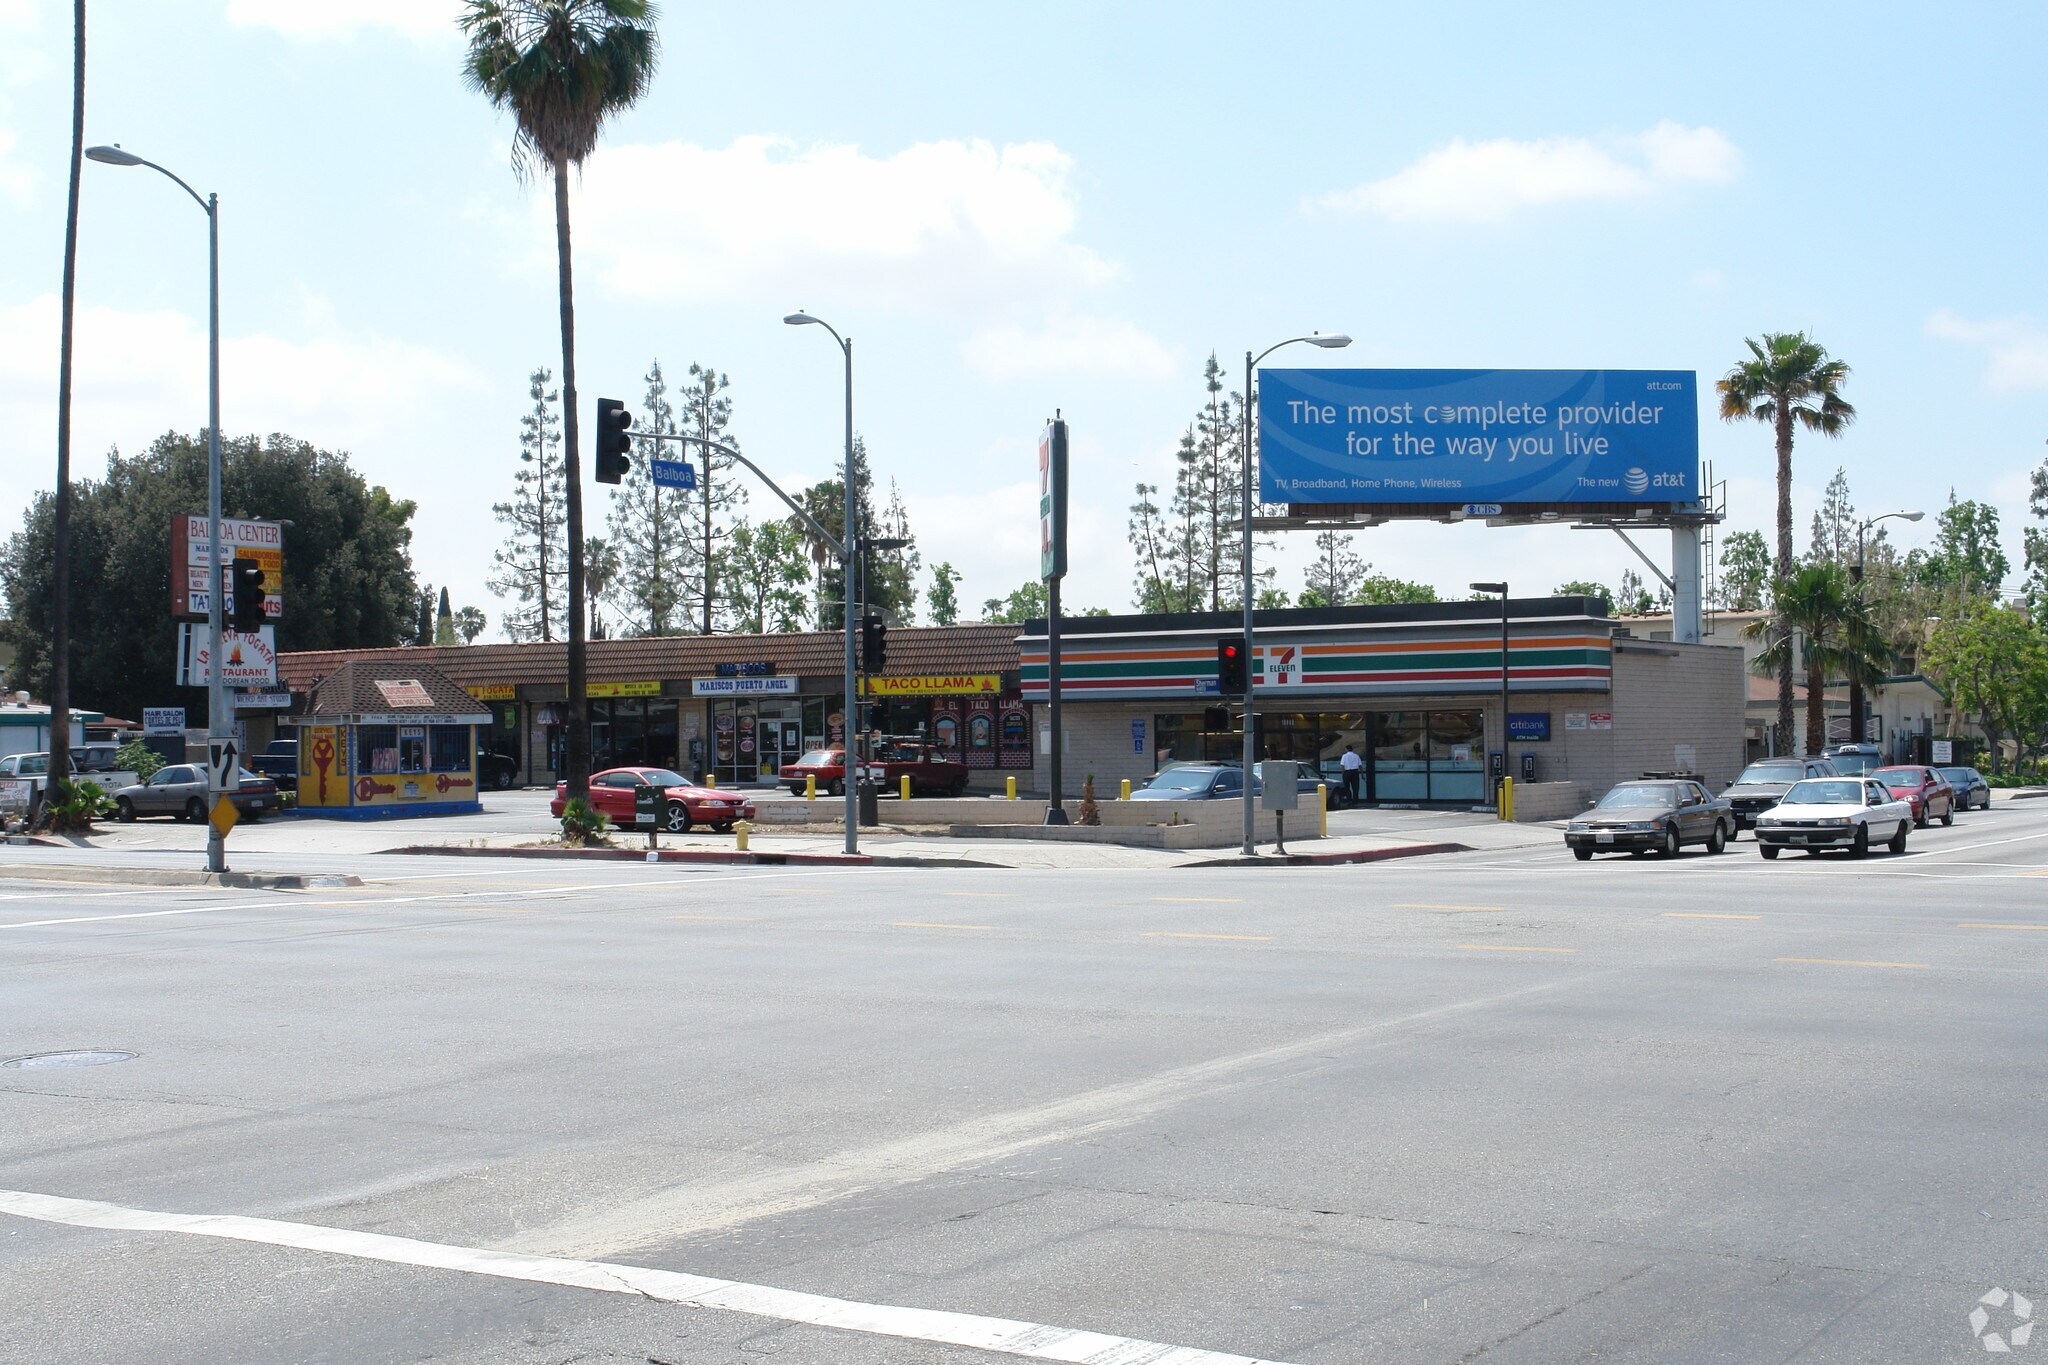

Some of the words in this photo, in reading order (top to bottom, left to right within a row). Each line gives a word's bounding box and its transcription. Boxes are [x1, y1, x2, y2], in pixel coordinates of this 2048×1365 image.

[1646, 380, 1682, 391] att.com
[1288, 401, 1336, 424] The
[1348, 402, 1413, 424] most
[1424, 400, 1547, 430] complete
[1558, 400, 1664, 430] provider
[1346, 431, 1383, 454] for
[1392, 432, 1436, 454] the
[1446, 437, 1499, 462] way
[1508, 437, 1554, 462] you
[1564, 431, 1608, 454] live
[655, 466, 692, 482] Balboa
[1274, 478, 1290, 490] TV,
[1292, 478, 1348, 490] Broadband,
[1352, 478, 1380, 488] Home
[1384, 478, 1418, 490] Phone,
[1421, 478, 1462, 488] Wireless
[1577, 477, 1596, 487] The
[1598, 478, 1619, 487] new
[1652, 471, 1686, 488] at&t
[1477, 505, 1497, 514] CBS
[191, 520, 234, 540] BALOA
[238, 524, 278, 544] CENTER
[196, 544, 228, 554] MAROS
[264, 560, 280, 569] FOOD
[244, 633, 275, 665] FOGATA
[204, 668, 268, 676] RTAURANT
[700, 682, 733, 690] MARISCOS
[736, 680, 763, 689] PUERTO
[765, 680, 788, 689] ANGEL
[882, 678, 920, 689] TACO
[925, 677, 975, 688] LLAMA
[482, 686, 514, 694] FOGATA
[970, 700, 989, 709] TACO
[999, 700, 1023, 709] LLAMA
[1510, 720, 1544, 729] citibank
[805, 740, 823, 749] OPEN
